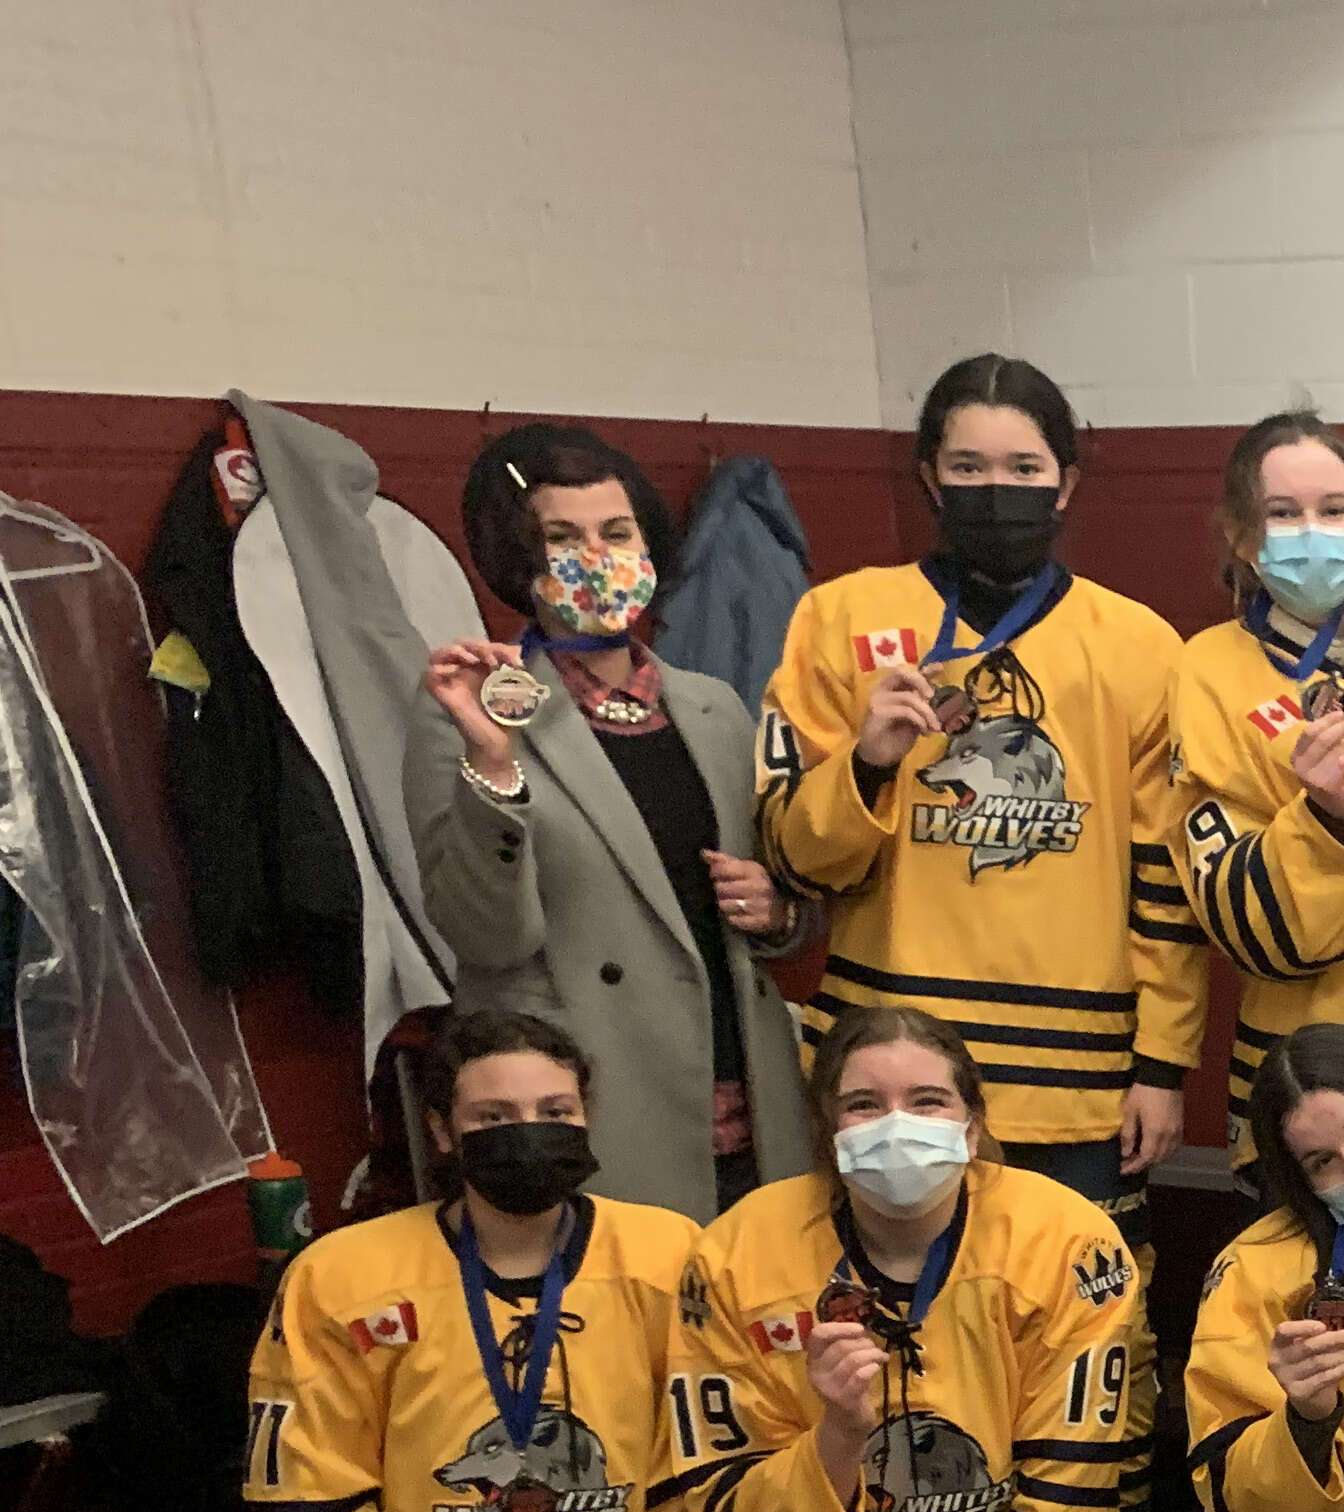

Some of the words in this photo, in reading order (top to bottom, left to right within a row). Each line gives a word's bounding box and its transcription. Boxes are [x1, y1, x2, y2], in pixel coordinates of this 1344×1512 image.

[911, 803, 1085, 853] WOLVES
[979, 794, 1090, 823] WHITBY
[668, 1373, 751, 1460] 19
[1063, 1344, 1128, 1428] 19
